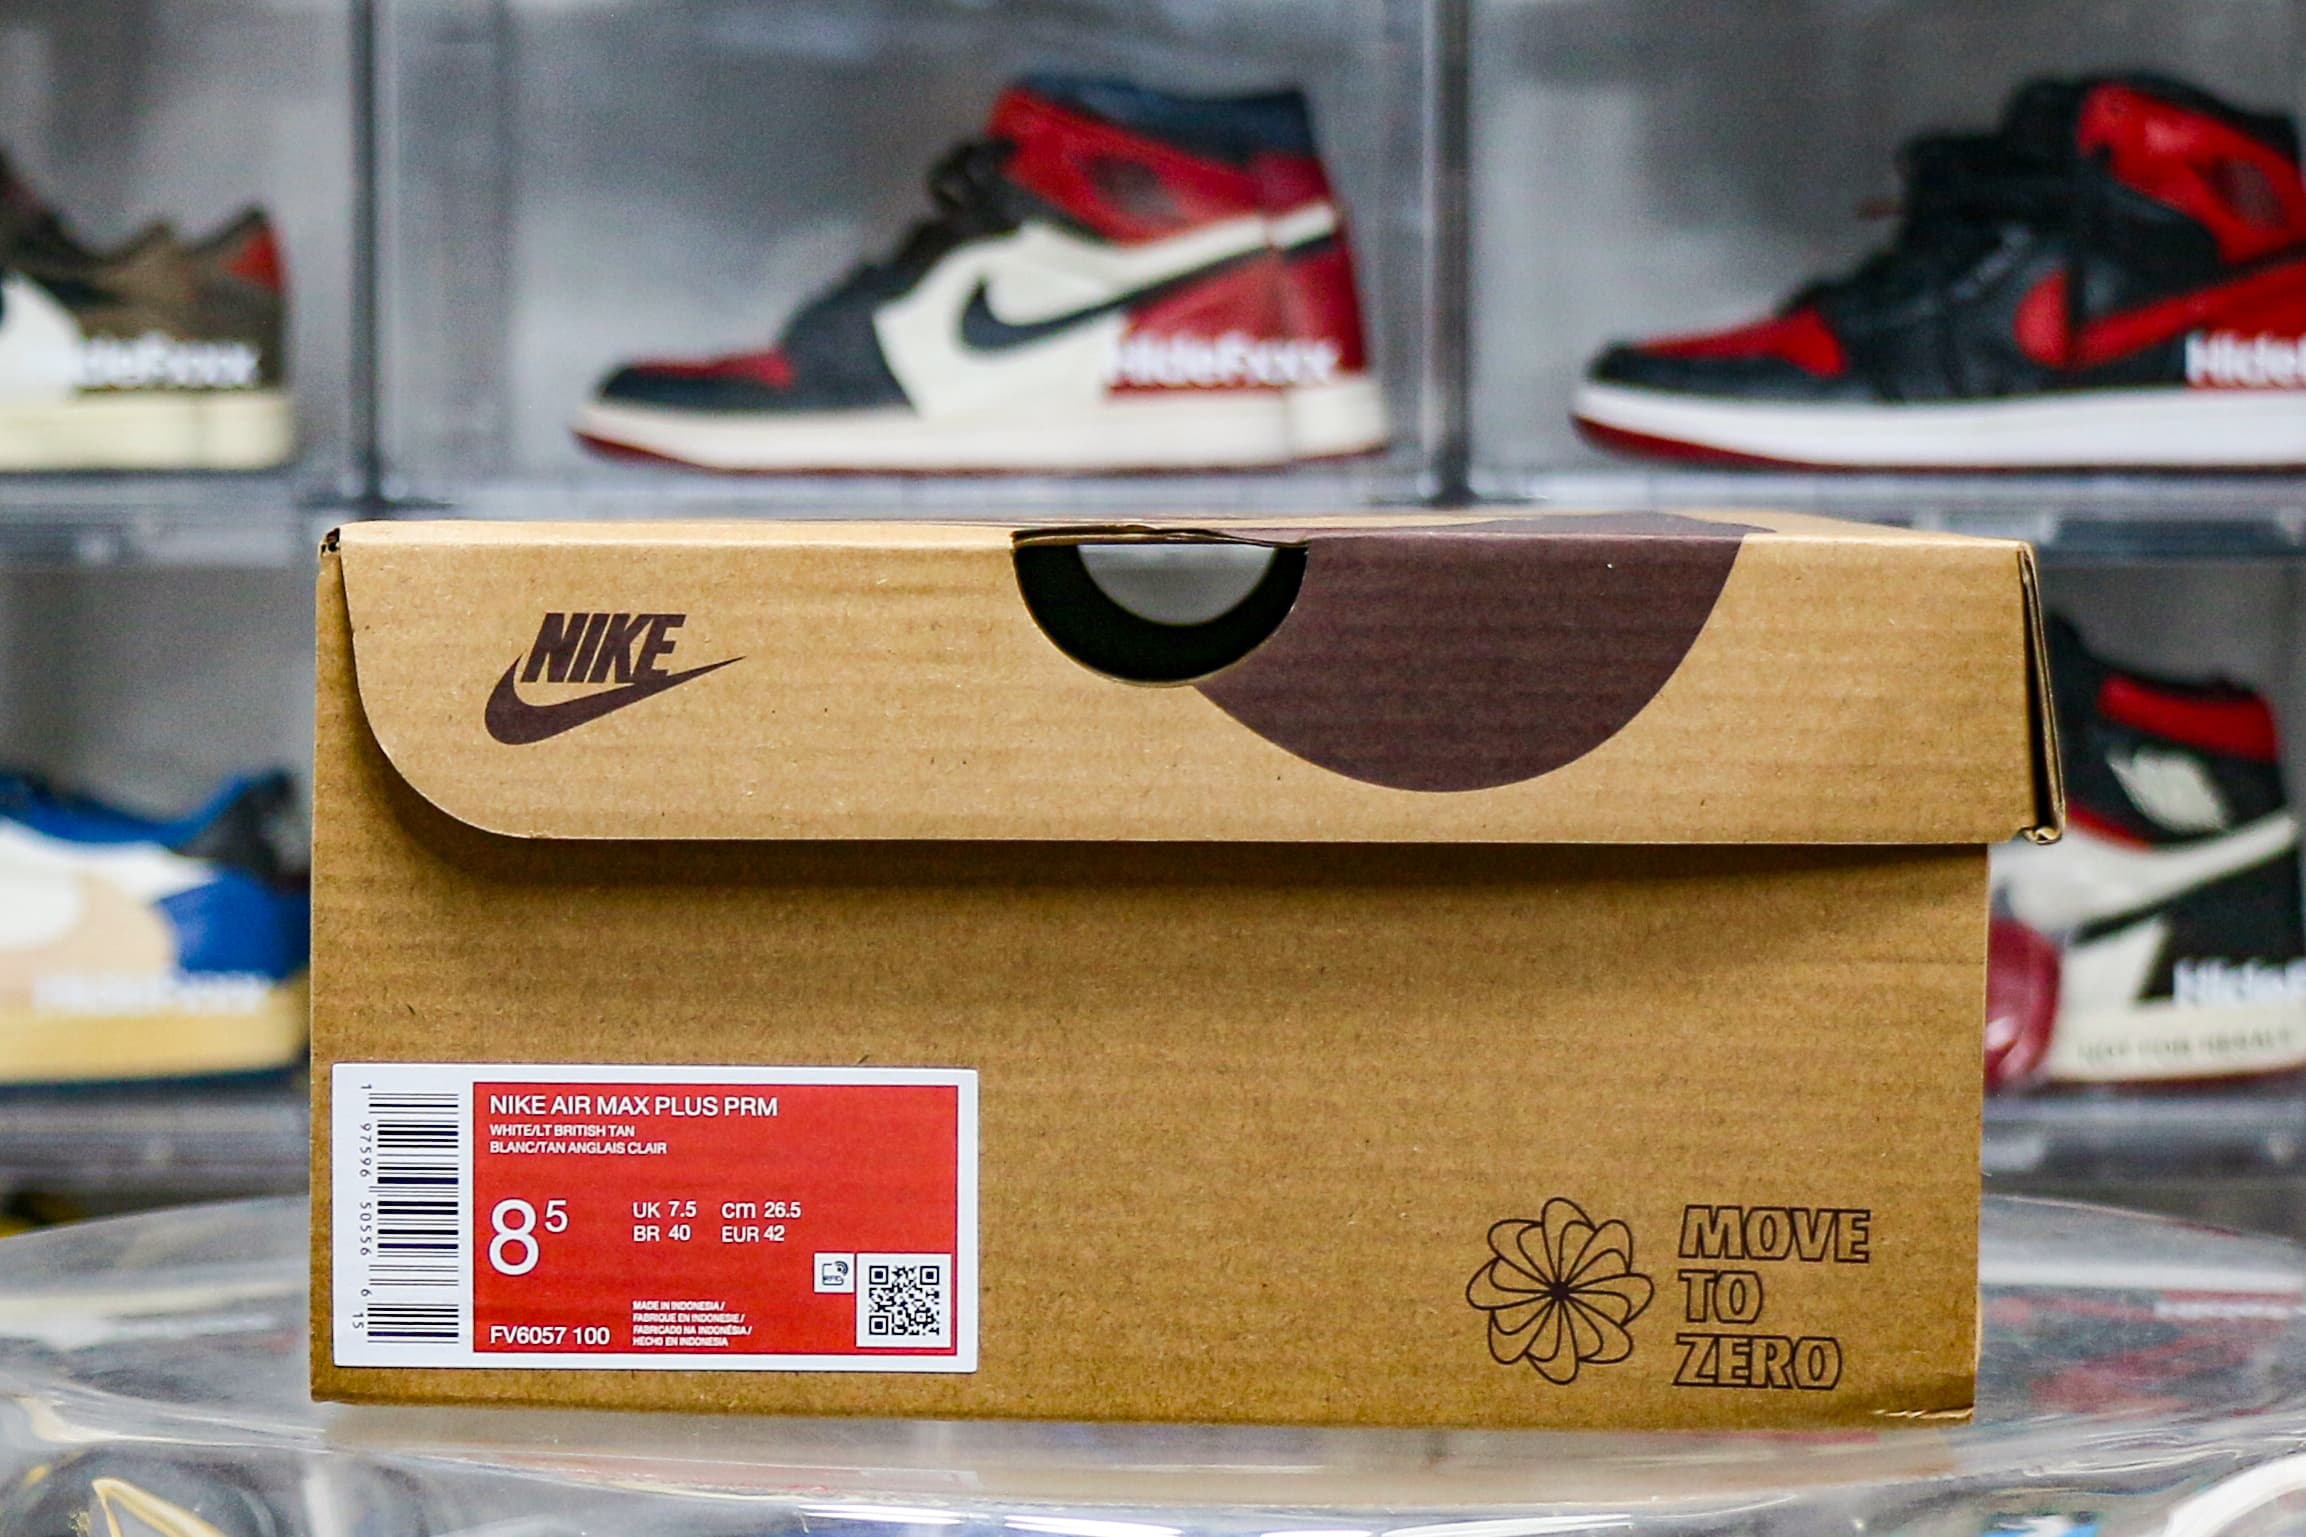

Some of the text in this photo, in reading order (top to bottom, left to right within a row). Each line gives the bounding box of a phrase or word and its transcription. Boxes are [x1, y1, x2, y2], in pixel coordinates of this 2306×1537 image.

[520, 612, 686, 684] NIKE
[489, 1095, 778, 1117] NIKE AIR MAX PLUS PRM
[489, 1124, 635, 1138] WHITE/LT BRITISH TAN
[360, 1122, 372, 1178] 97596
[489, 1141, 668, 1155] BLANC/TAN ANGLAIS CLAIR
[632, 1201, 698, 1219] UK 7.5
[721, 1202, 802, 1219] cm 26.5
[360, 1201, 372, 1256] 50556
[632, 1225, 692, 1242] BR 40
[721, 1225, 786, 1243] EUR 42
[1678, 1205, 1871, 1264] MOVE
[1678, 1269, 1764, 1324] TO
[489, 1326, 611, 1345] FV6057 100
[1672, 1333, 1843, 1391] ZERO
